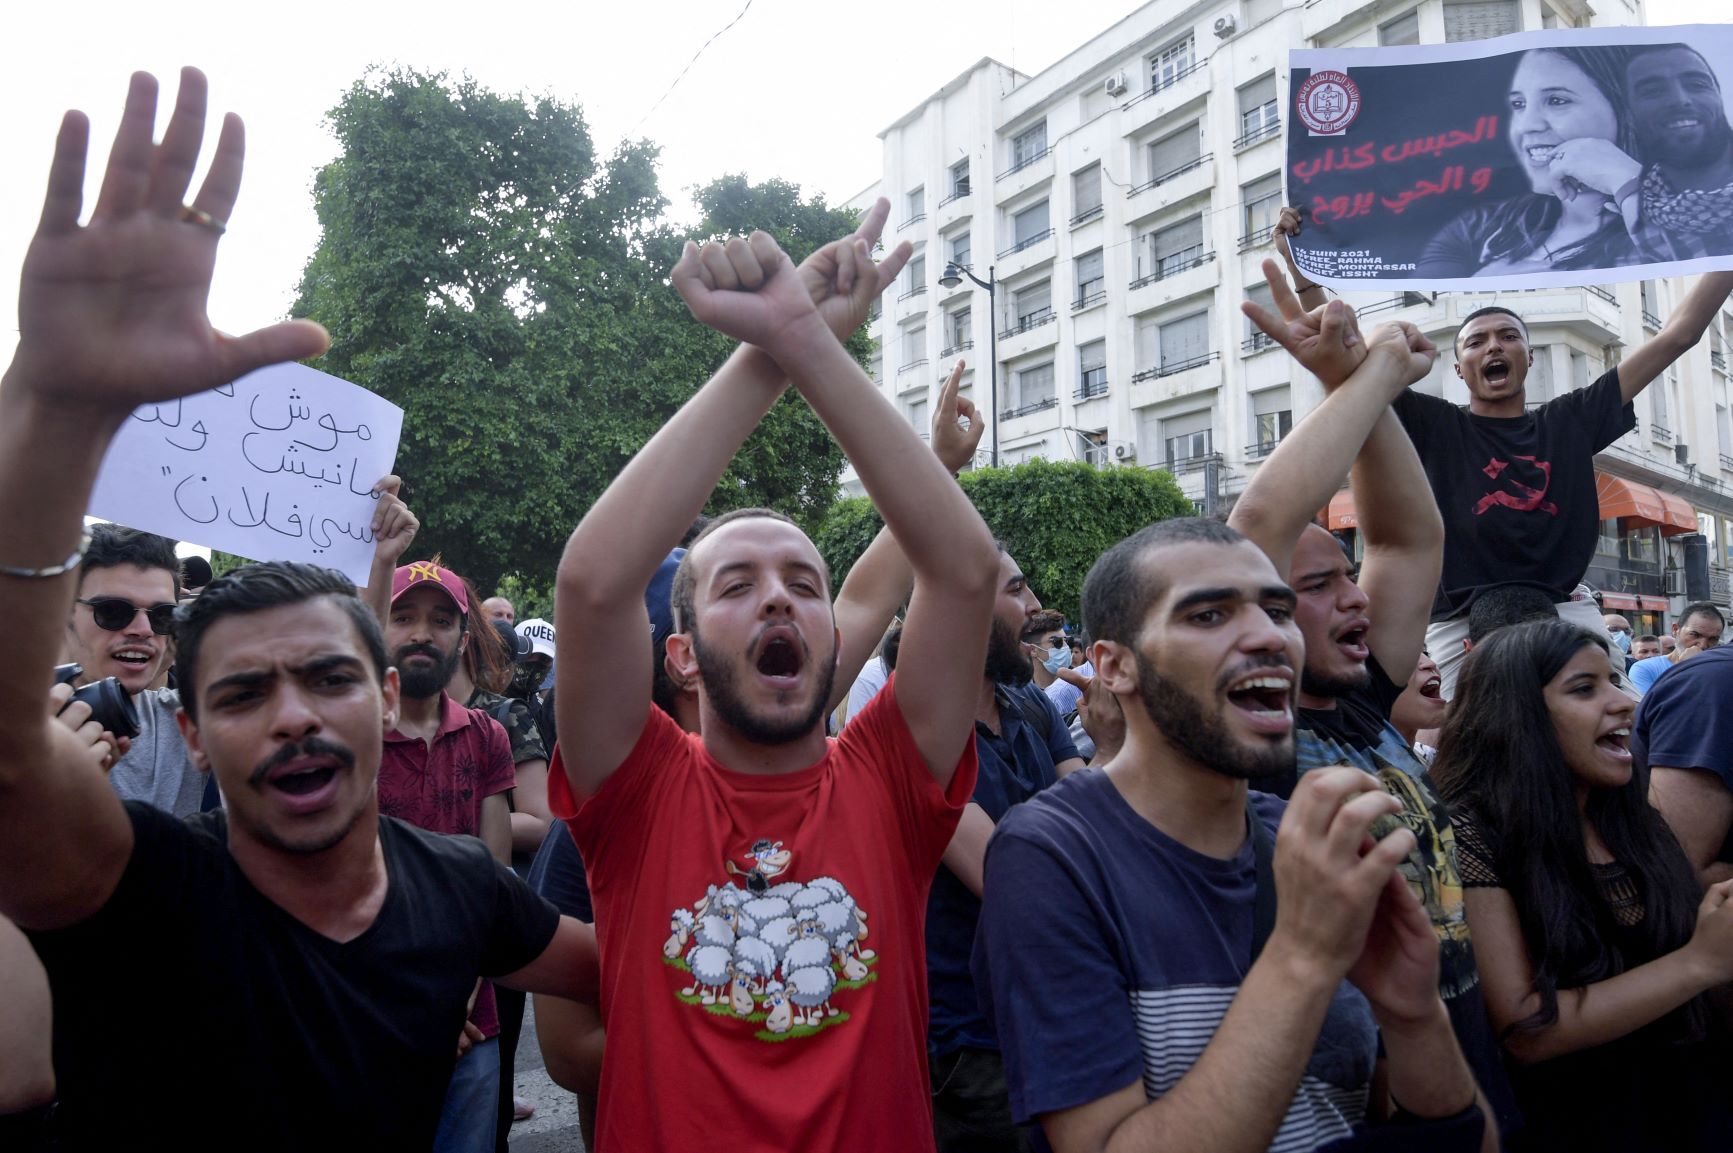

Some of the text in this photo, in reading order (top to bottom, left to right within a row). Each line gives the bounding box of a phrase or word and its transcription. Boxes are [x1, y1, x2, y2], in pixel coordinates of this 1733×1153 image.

[1382, 115, 1498, 162] الحبس
[1293, 142, 1376, 184] كذاب
[1381, 166, 1464, 215] الحي
[1312, 191, 1375, 225] يروح
[1295, 251, 1382, 265] #FREE_RAHMA
[1297, 257, 1416, 272] #FREE_MONTASSAR
[1309, 249, 1337, 257] JUIN
